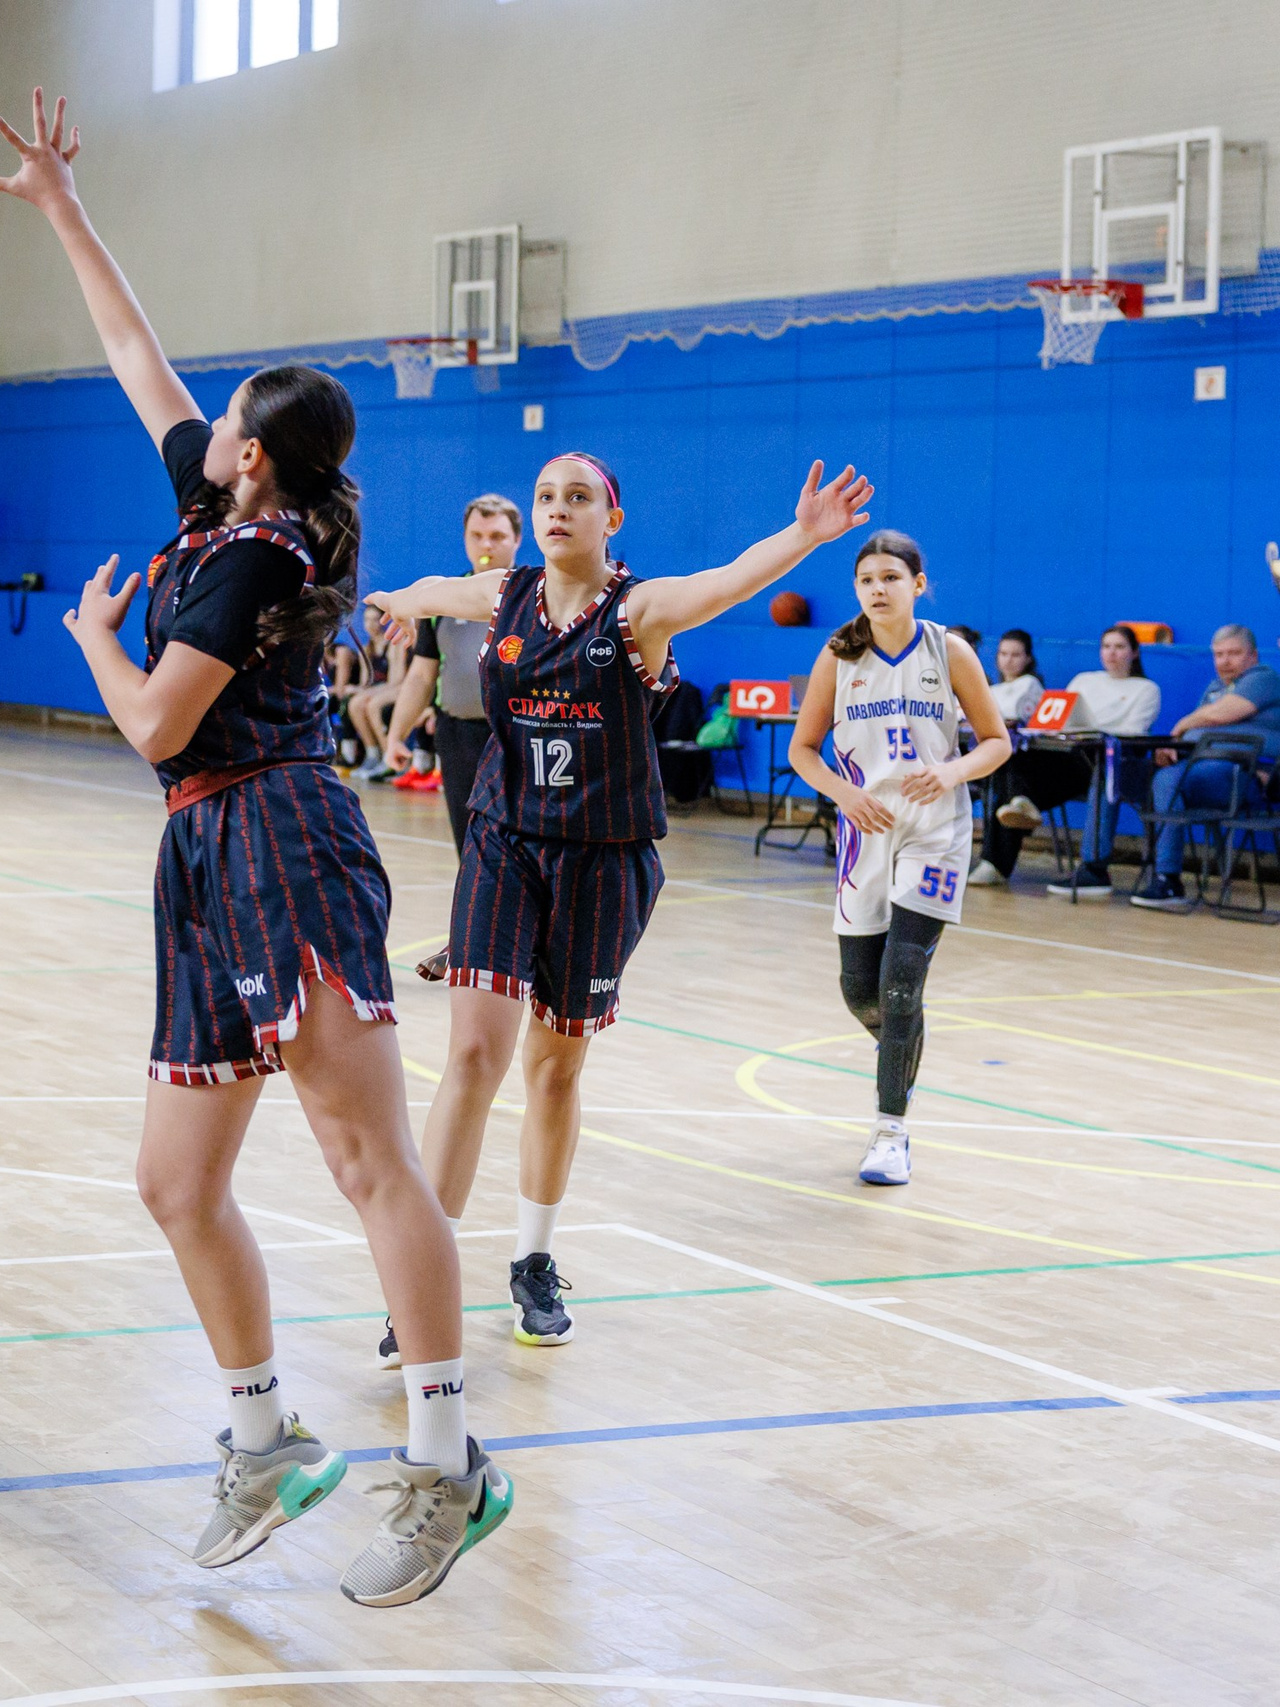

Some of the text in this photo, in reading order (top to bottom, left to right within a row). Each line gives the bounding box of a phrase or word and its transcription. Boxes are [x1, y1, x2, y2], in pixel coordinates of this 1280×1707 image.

[589, 647, 613, 656] РФБ
[909, 699, 944, 721] ПОСАД
[576, 721, 603, 730] Видное
[884, 725, 919, 763] 55
[530, 738, 575, 787] 12
[918, 864, 959, 905] 55
[234, 972, 268, 1000] ФК
[589, 977, 618, 994] ШФК
[230, 1375, 279, 1398] FILA
